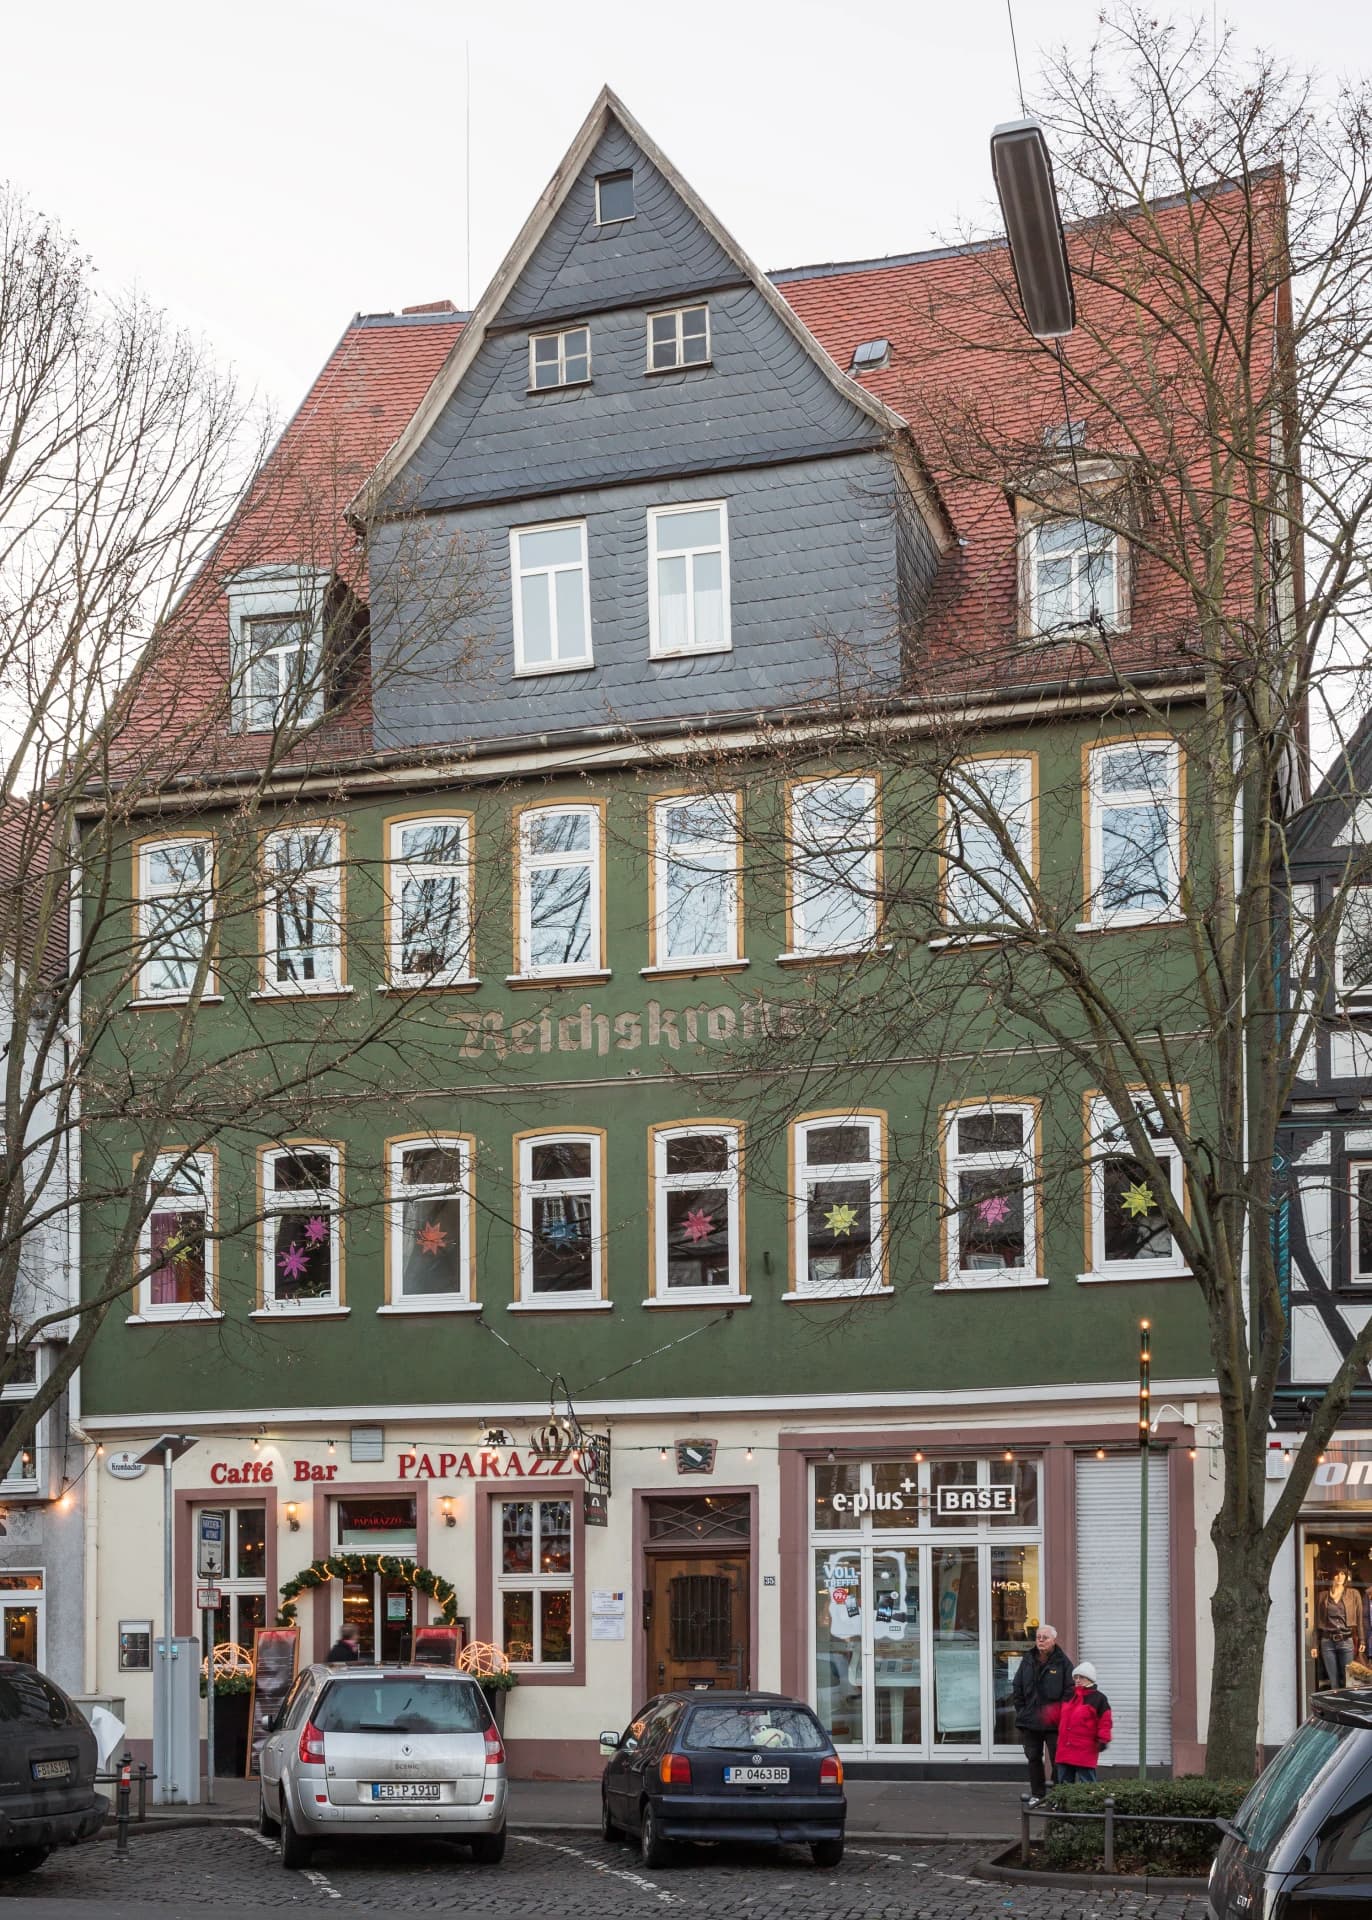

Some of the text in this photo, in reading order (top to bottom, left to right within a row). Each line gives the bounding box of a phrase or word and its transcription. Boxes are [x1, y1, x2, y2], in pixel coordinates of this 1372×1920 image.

[211, 1460, 274, 1484] Caffé
[293, 1460, 338, 1482] Bar
[945, 1490, 1007, 1510] BASE
